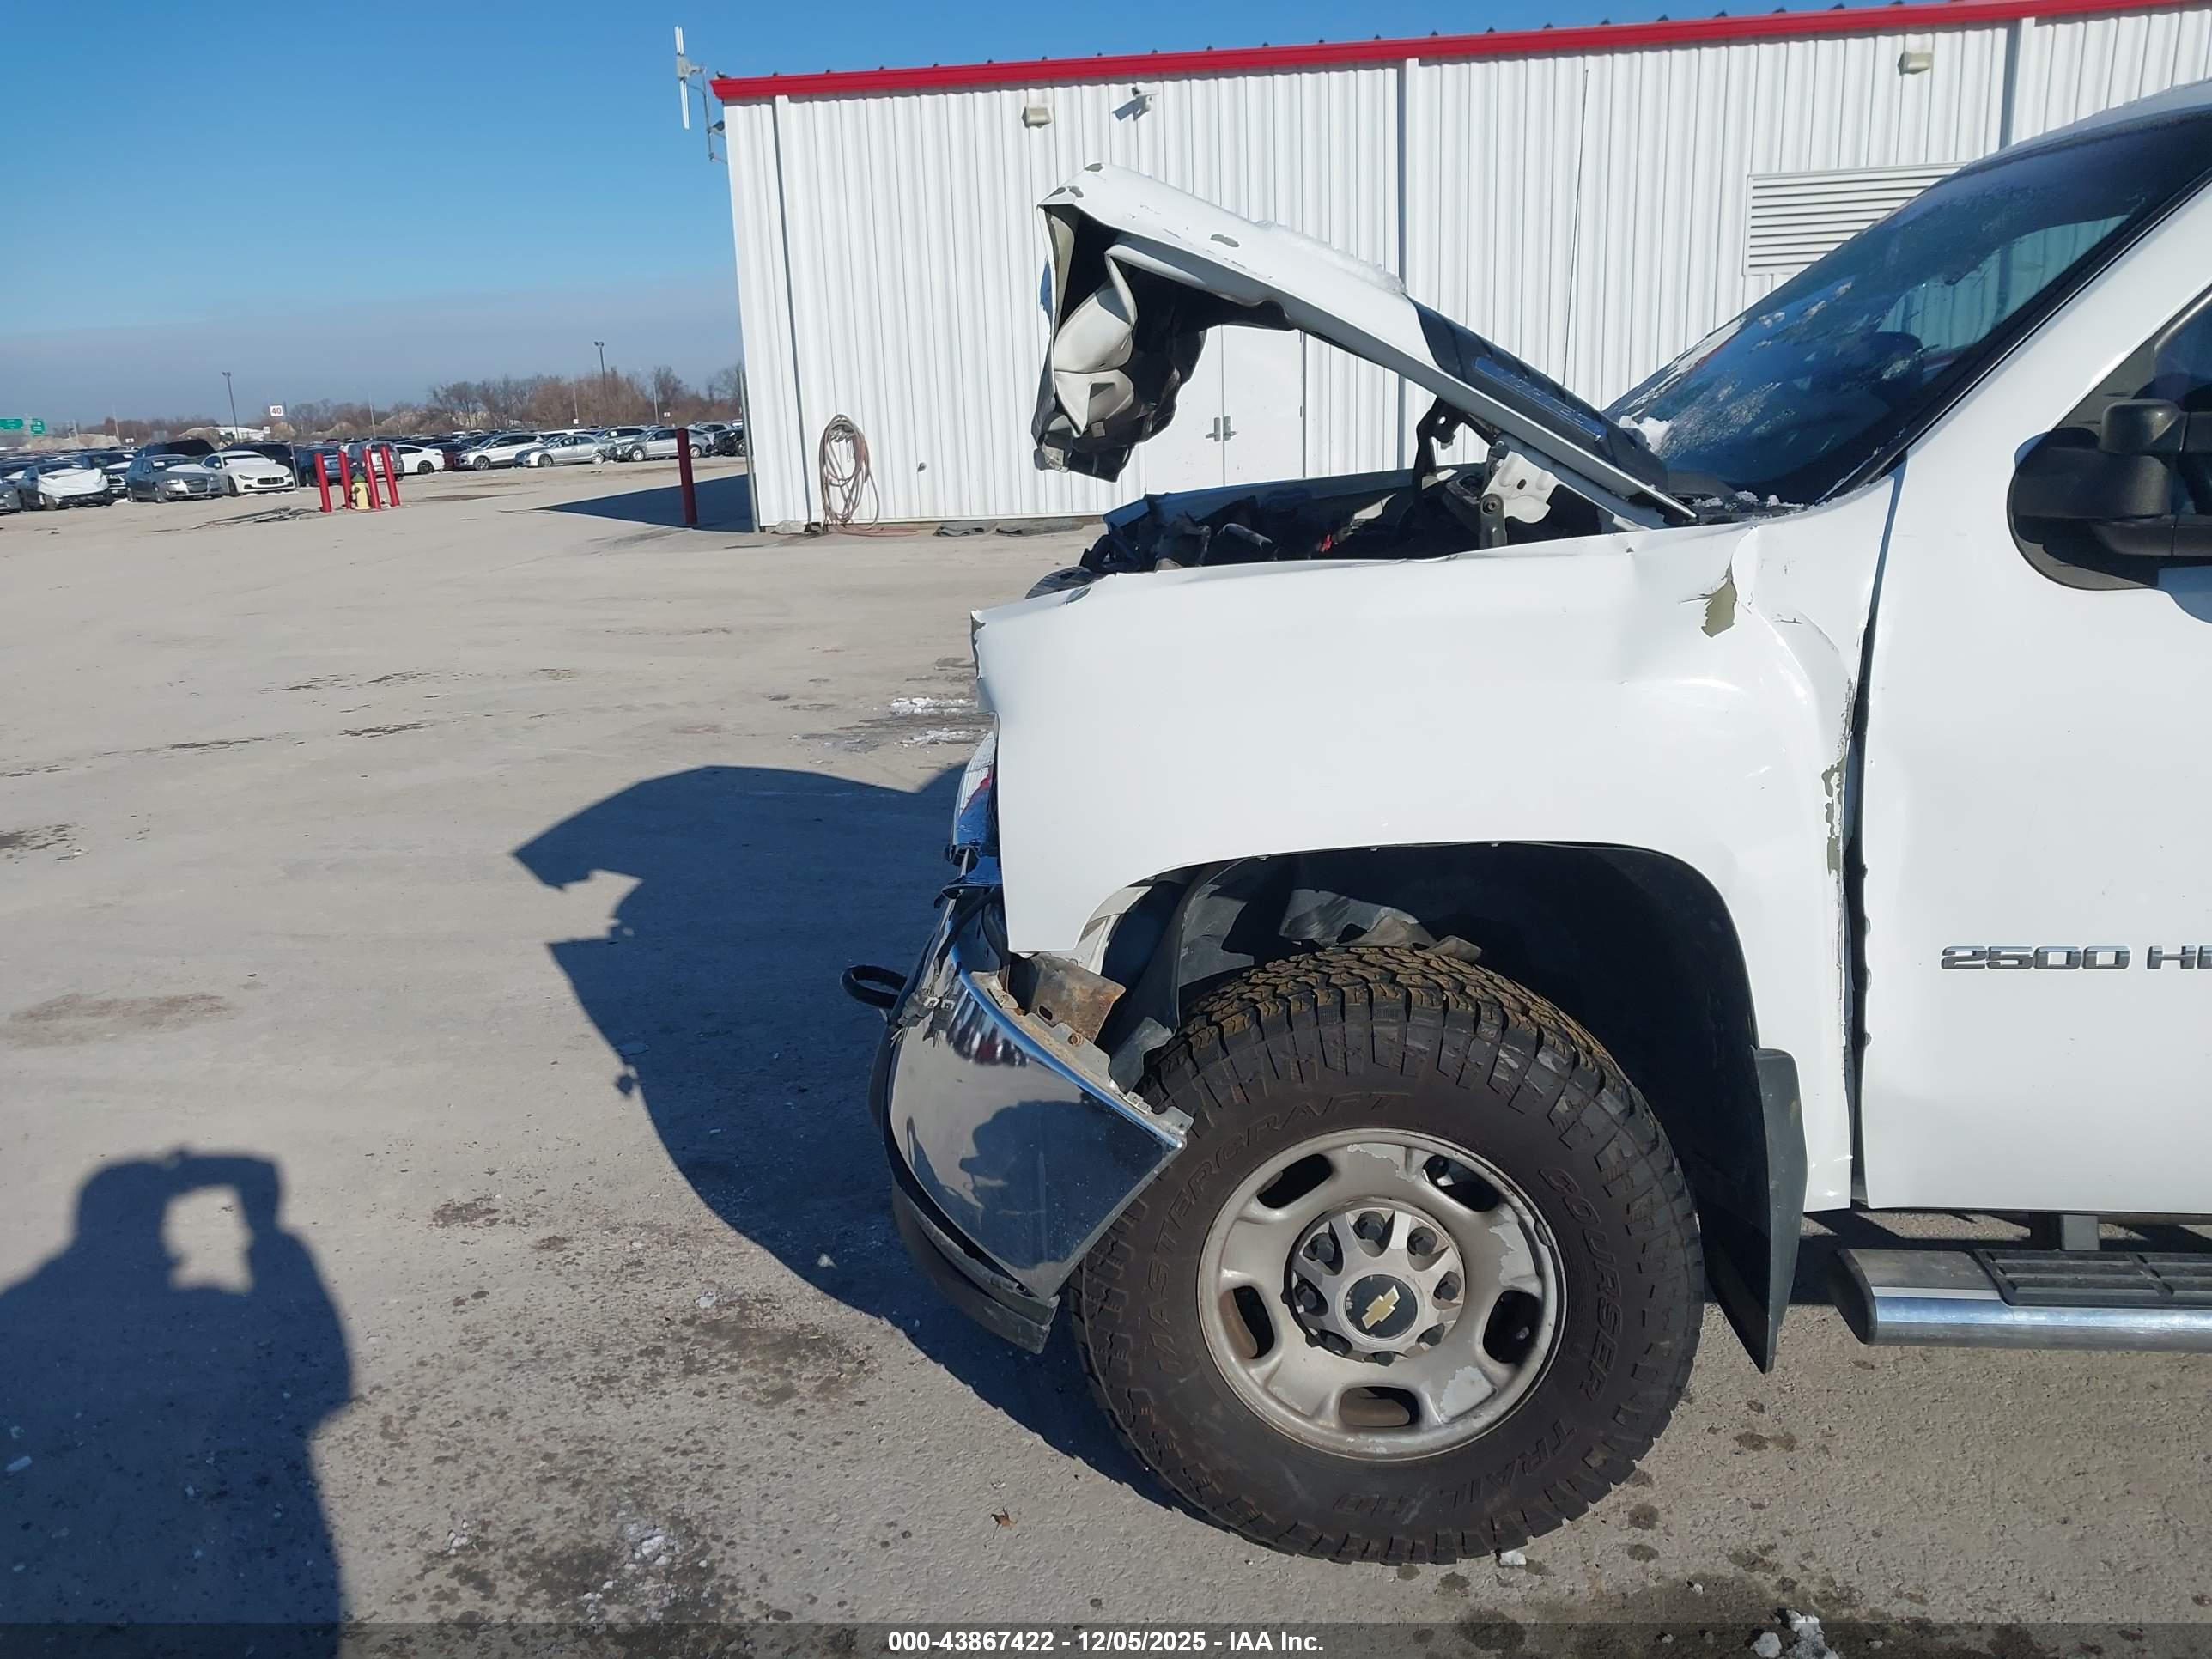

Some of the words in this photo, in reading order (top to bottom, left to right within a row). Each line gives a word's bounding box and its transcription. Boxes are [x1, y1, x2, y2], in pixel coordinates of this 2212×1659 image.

[1941, 945, 2130, 970] 2500
[1148, 1091, 1411, 1374] MASTERCRAFT
[1538, 1166, 1623, 1402] COURSER
[1437, 1416, 1579, 1509] TRAIL
